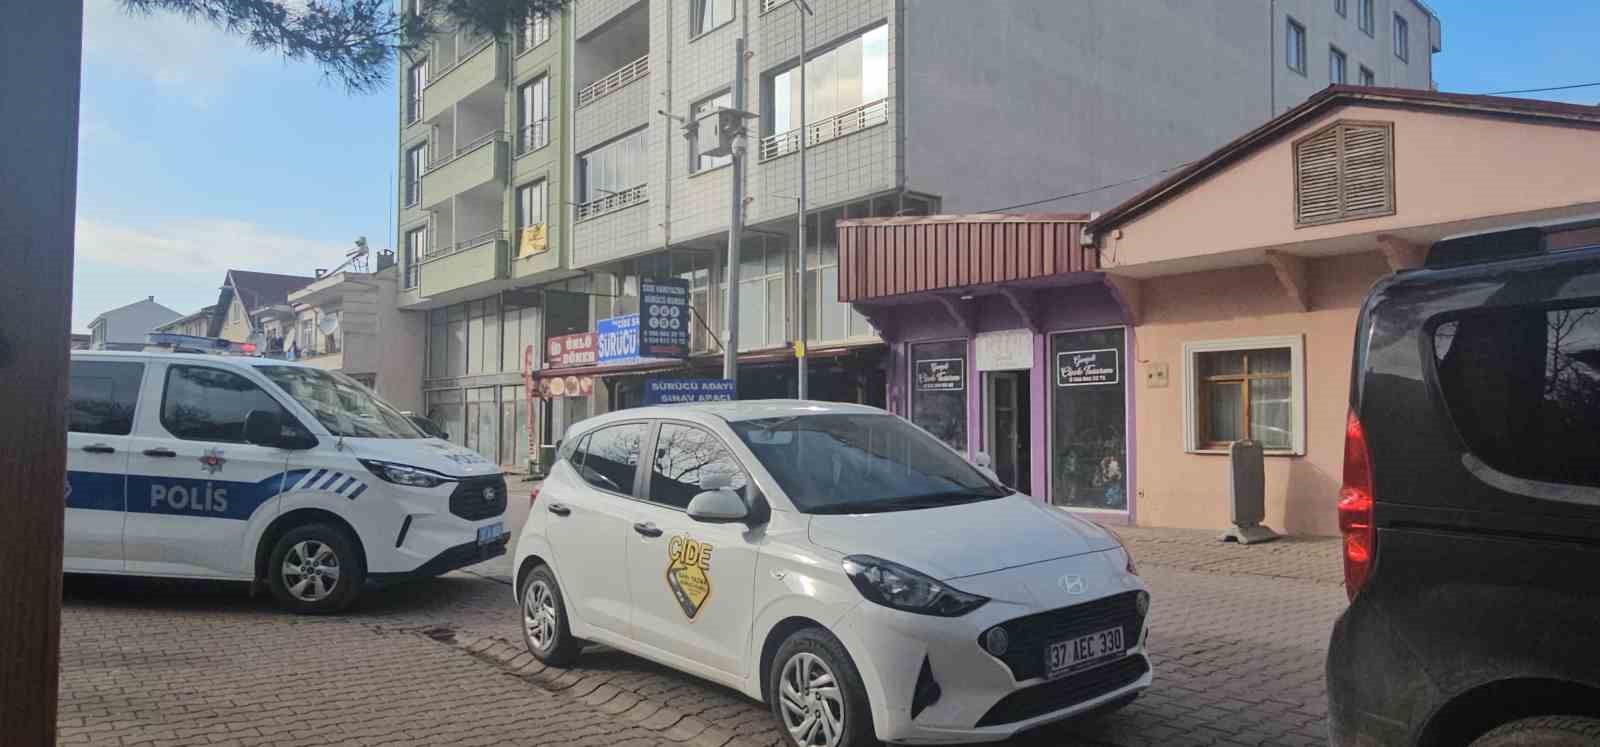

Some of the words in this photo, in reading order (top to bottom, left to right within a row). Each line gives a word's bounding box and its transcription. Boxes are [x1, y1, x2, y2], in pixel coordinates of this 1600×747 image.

[599, 328, 637, 359] SÜRÜCÜ
[150, 481, 228, 513] POLİS
[1053, 644, 1066, 669] 37
[1073, 637, 1095, 661] AEC
[1099, 629, 1122, 654] 330
